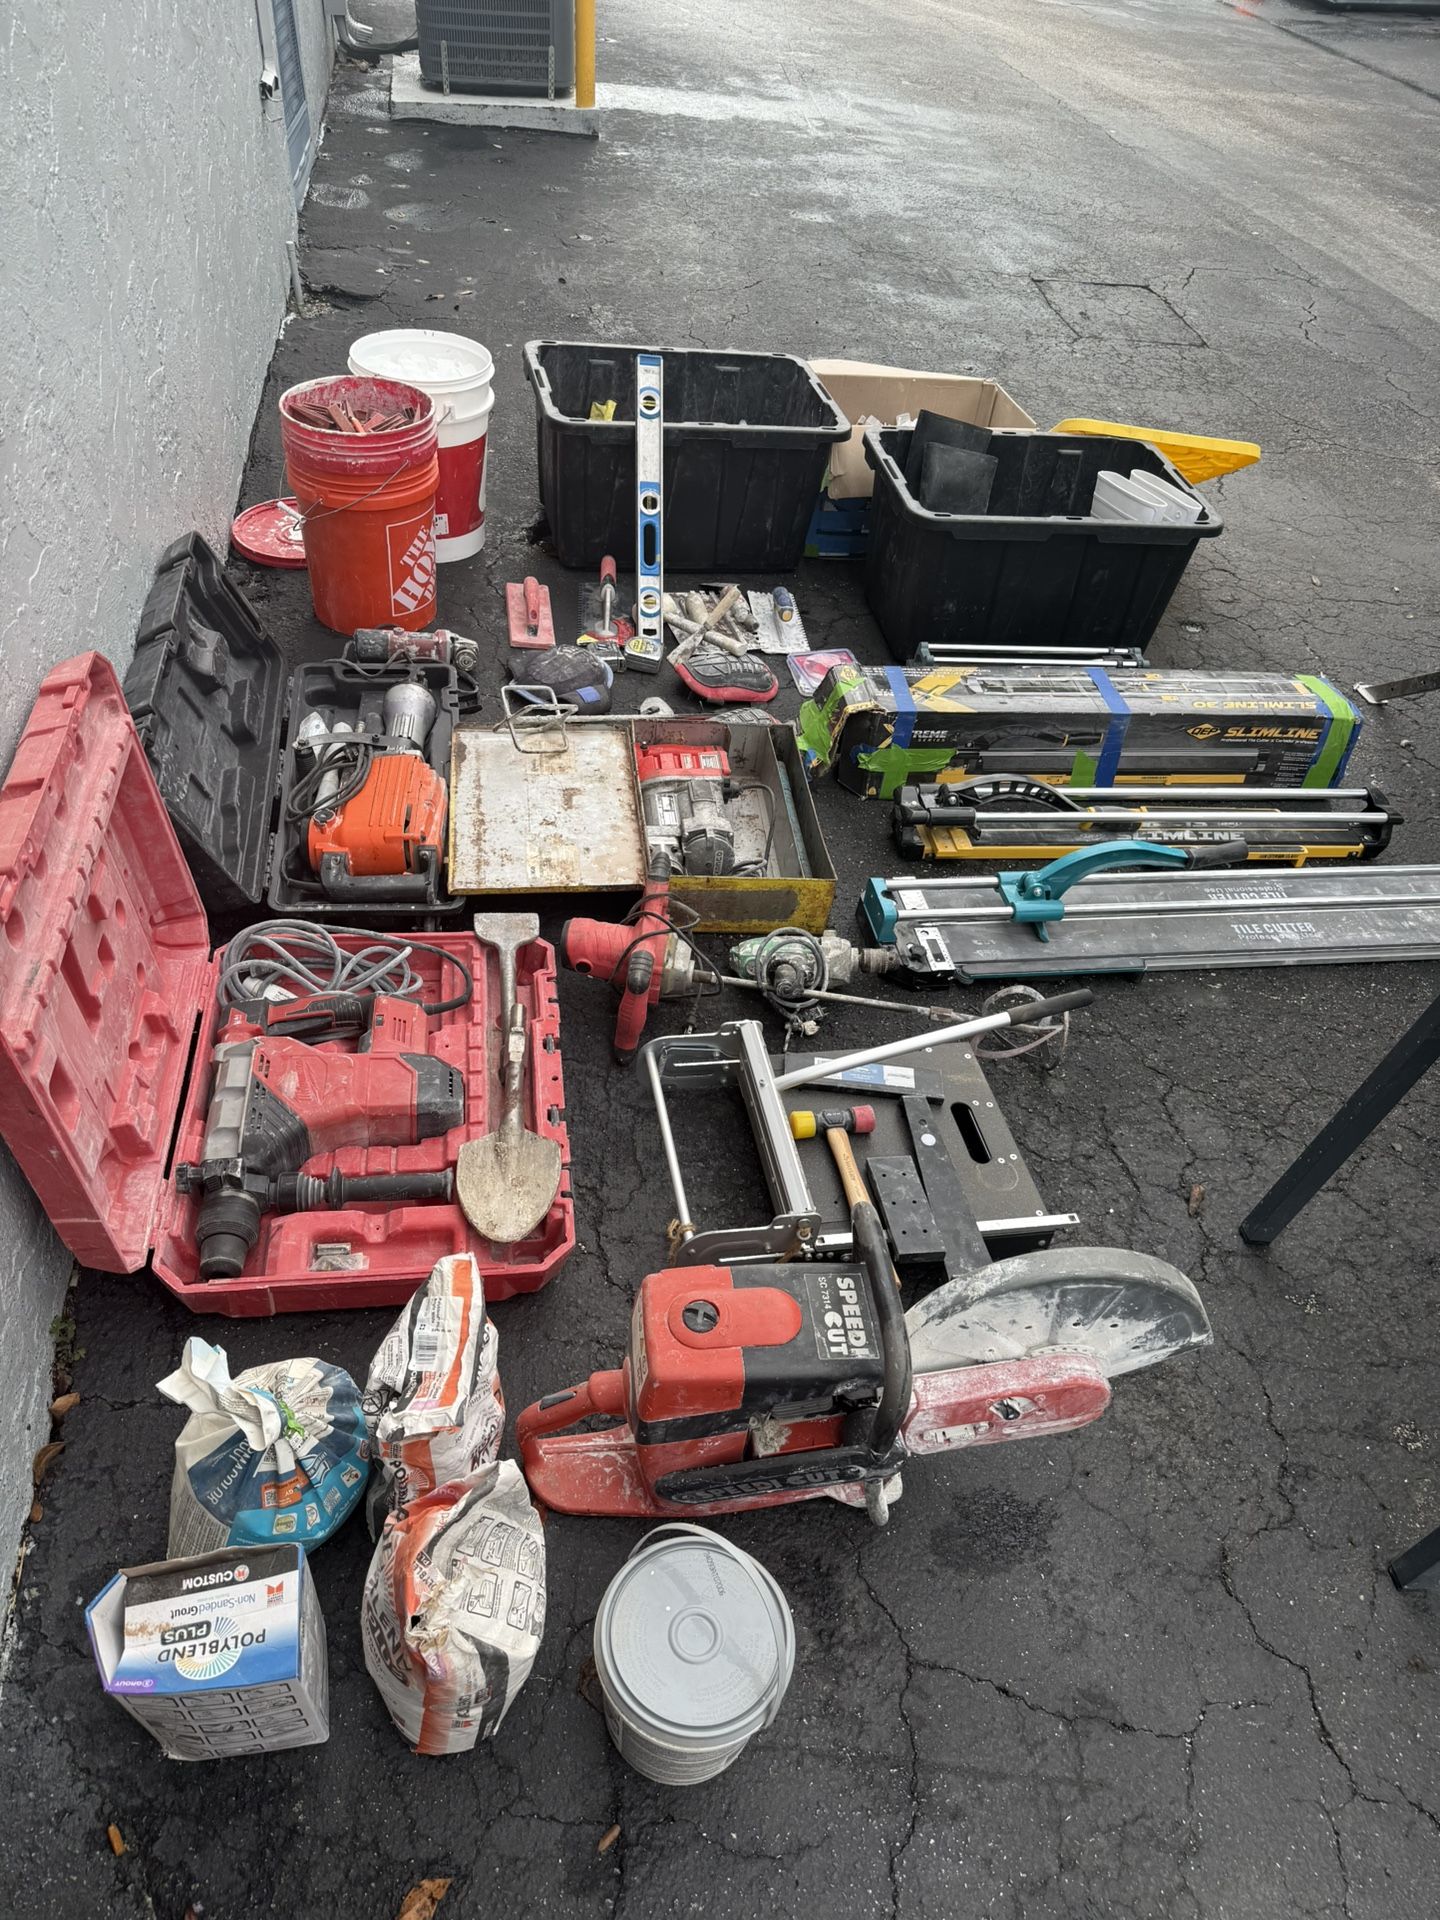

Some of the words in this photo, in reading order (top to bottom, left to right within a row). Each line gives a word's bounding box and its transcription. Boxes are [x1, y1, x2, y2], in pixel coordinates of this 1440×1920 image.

[400, 524, 430, 567] THE
[1193, 700, 1218, 709] 30
[1223, 699, 1317, 710] SLIMLINE
[1223, 726, 1323, 739] SLIMLINE
[1230, 923, 1262, 935] TILE
[1263, 922, 1316, 934] CUTTER
[821, 1290, 832, 1309] 7314
[837, 1276, 870, 1357] SPEEDI
[824, 1311, 849, 1355] CUT
[693, 1477, 780, 1500] SPEEDI
[786, 1468, 842, 1488] CUT
[182, 1570, 234, 1591] CUSTOM
[170, 1604, 199, 1619] Grout
[199, 1593, 256, 1614] Non-Sanded
[163, 1622, 208, 1643] PLUS
[157, 1628, 266, 1663] POLYBLEND
